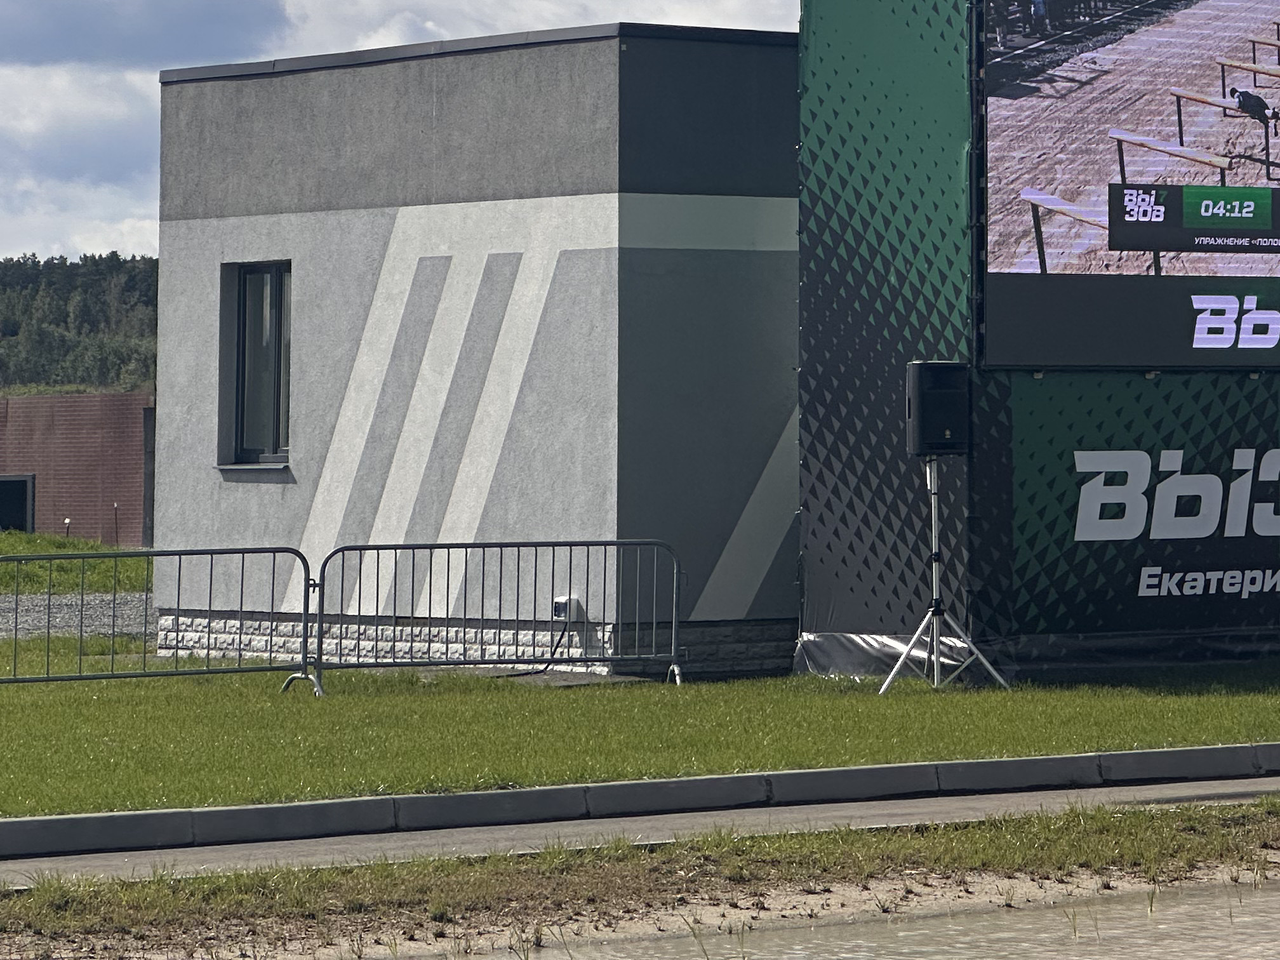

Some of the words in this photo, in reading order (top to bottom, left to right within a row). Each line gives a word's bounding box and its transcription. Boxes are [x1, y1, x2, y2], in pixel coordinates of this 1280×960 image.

[1123, 189, 1156, 207] ВЫ
[1158, 190, 1169, 203] 7
[1124, 205, 1165, 222] ЗОВ
[1200, 200, 1255, 218] 04:12
[1194, 236, 1250, 246] УПРАЖНЕНИЕ
